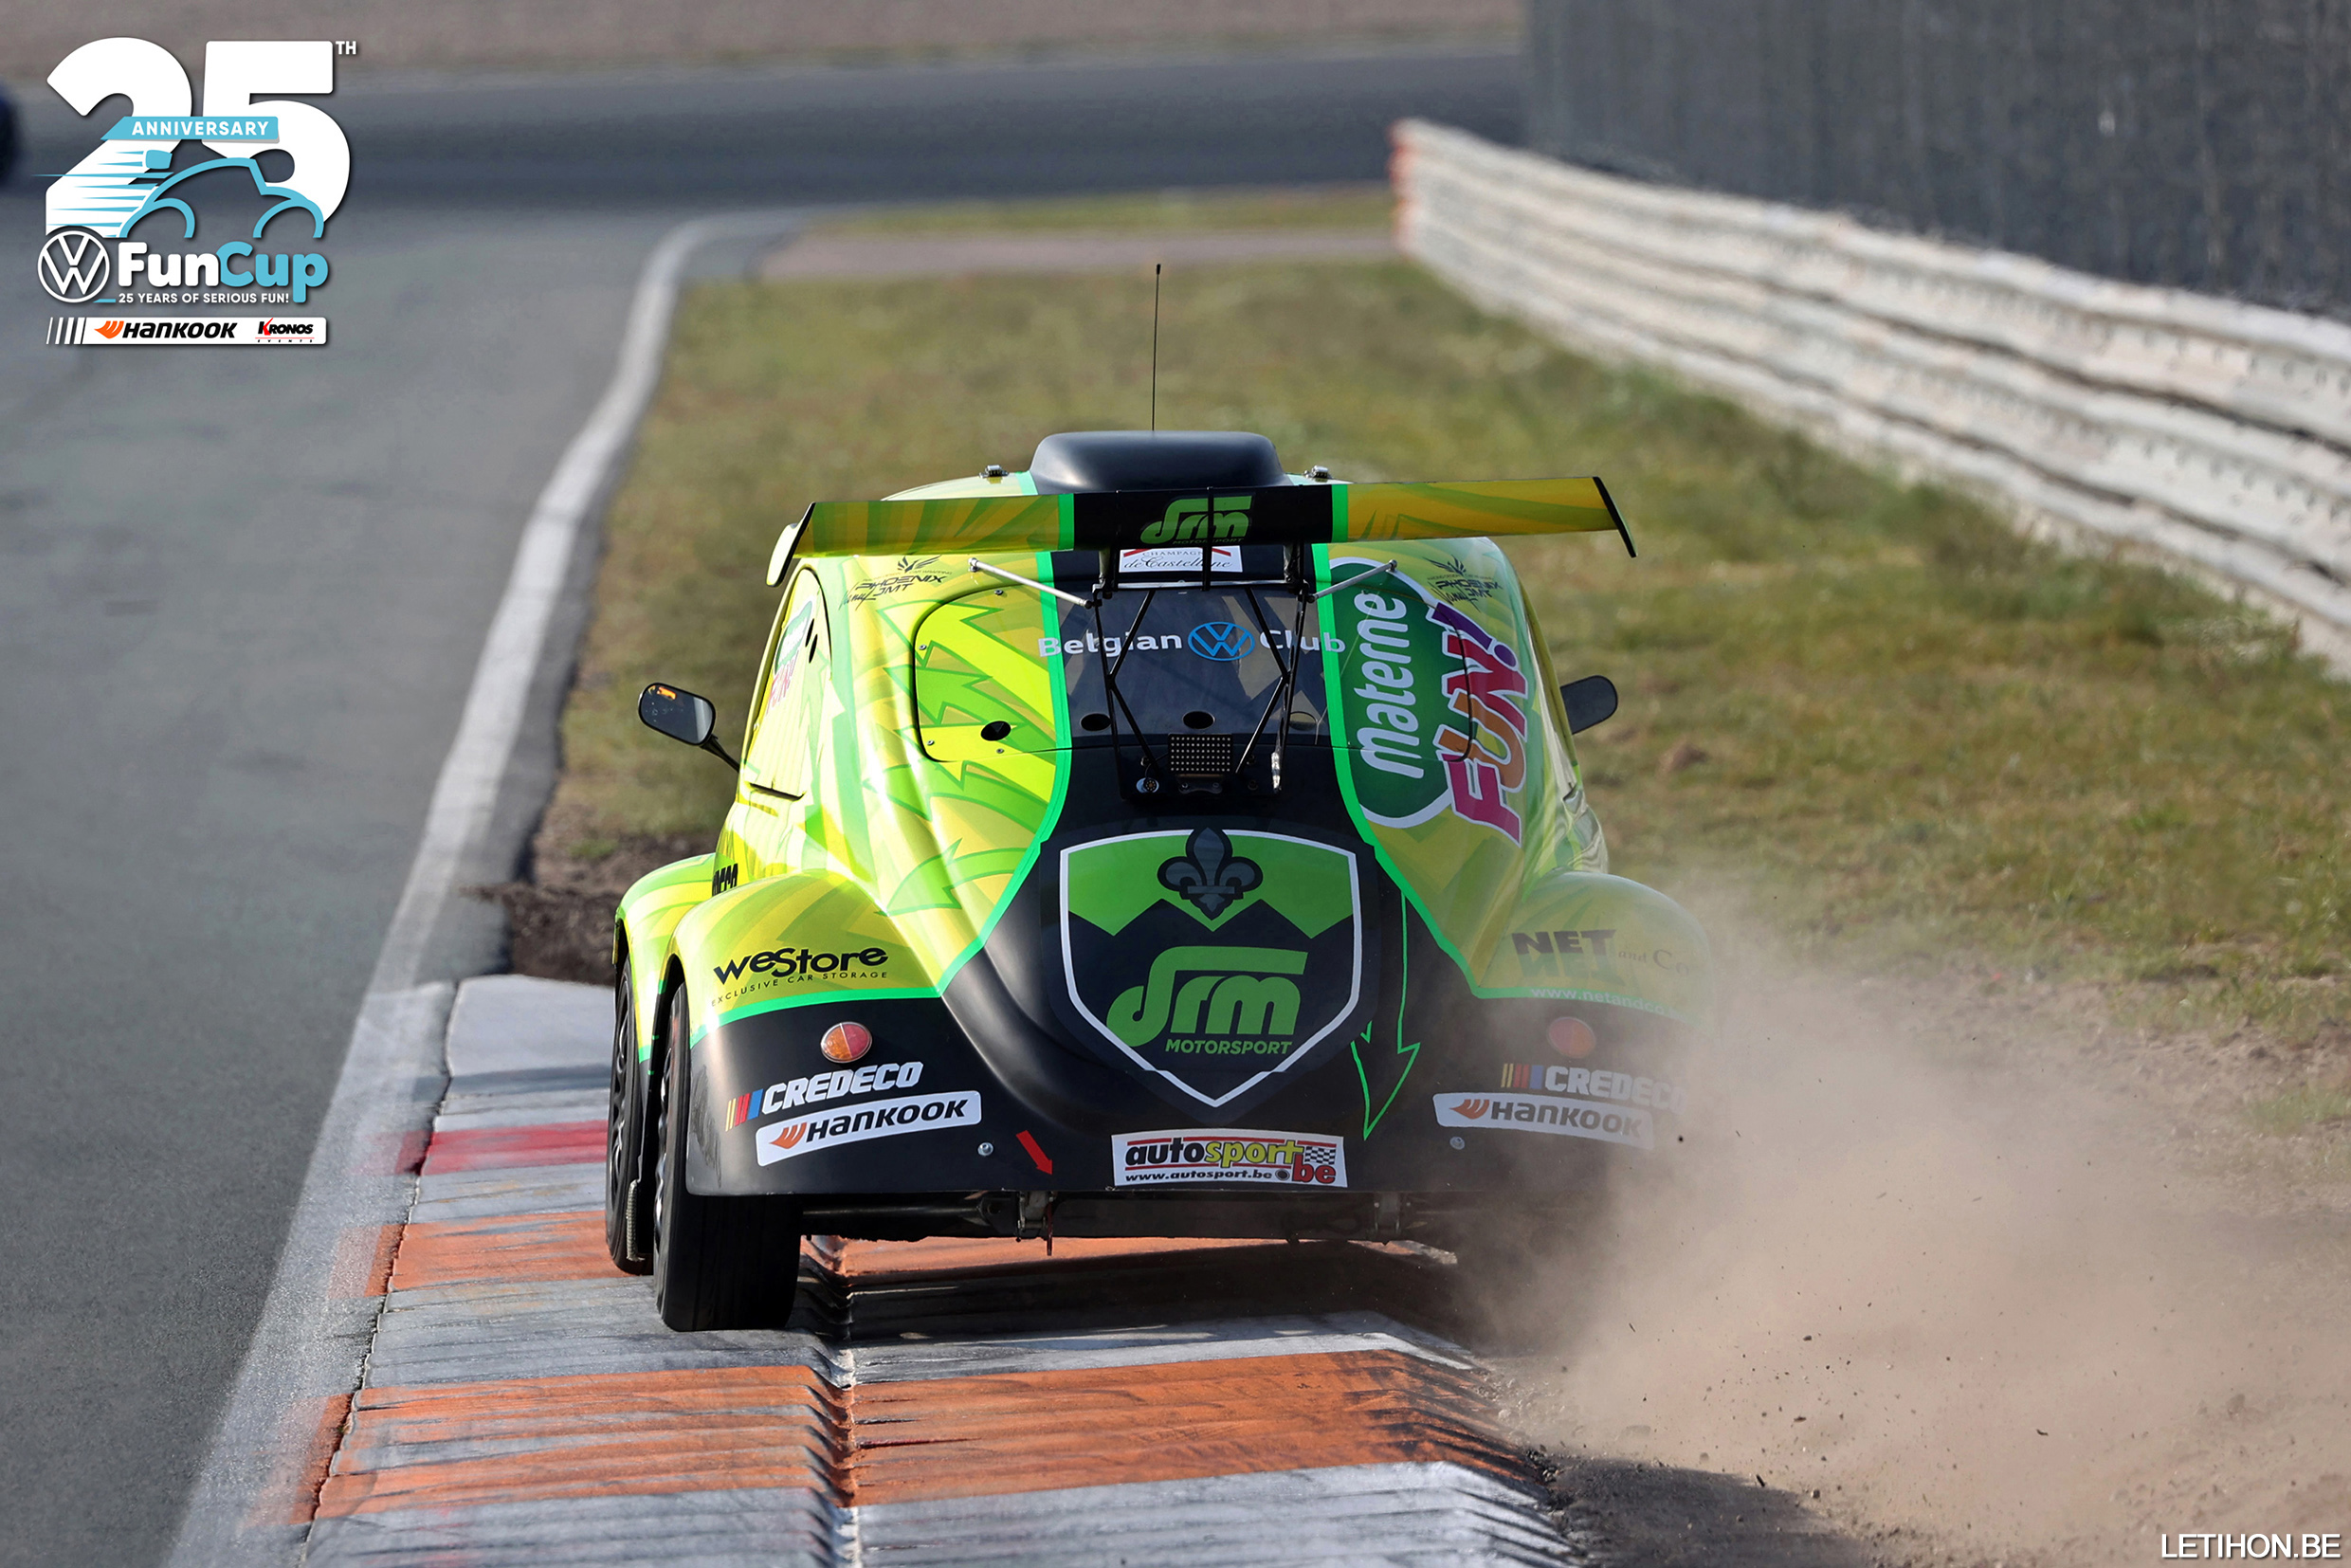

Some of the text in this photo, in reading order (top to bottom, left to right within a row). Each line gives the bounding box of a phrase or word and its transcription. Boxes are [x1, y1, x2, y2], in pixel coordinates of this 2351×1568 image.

[1141, 556, 1232, 568] Castellne
[1038, 632, 1182, 658] Belgian
[1260, 629, 1346, 653] Club
[1426, 602, 1528, 847] FUN!
[1511, 929, 1616, 955] NET
[712, 979, 778, 1007] EXCLUSIVE
[788, 975, 813, 983] CAR
[1165, 1039, 1292, 1054] MOTORSPORT
[761, 1061, 923, 1115] CREDECO
[1545, 1066, 1687, 1115] CREDECO
[1125, 1138, 1304, 1168] autosport
[1125, 1169, 1272, 1182] www.autosport.be
